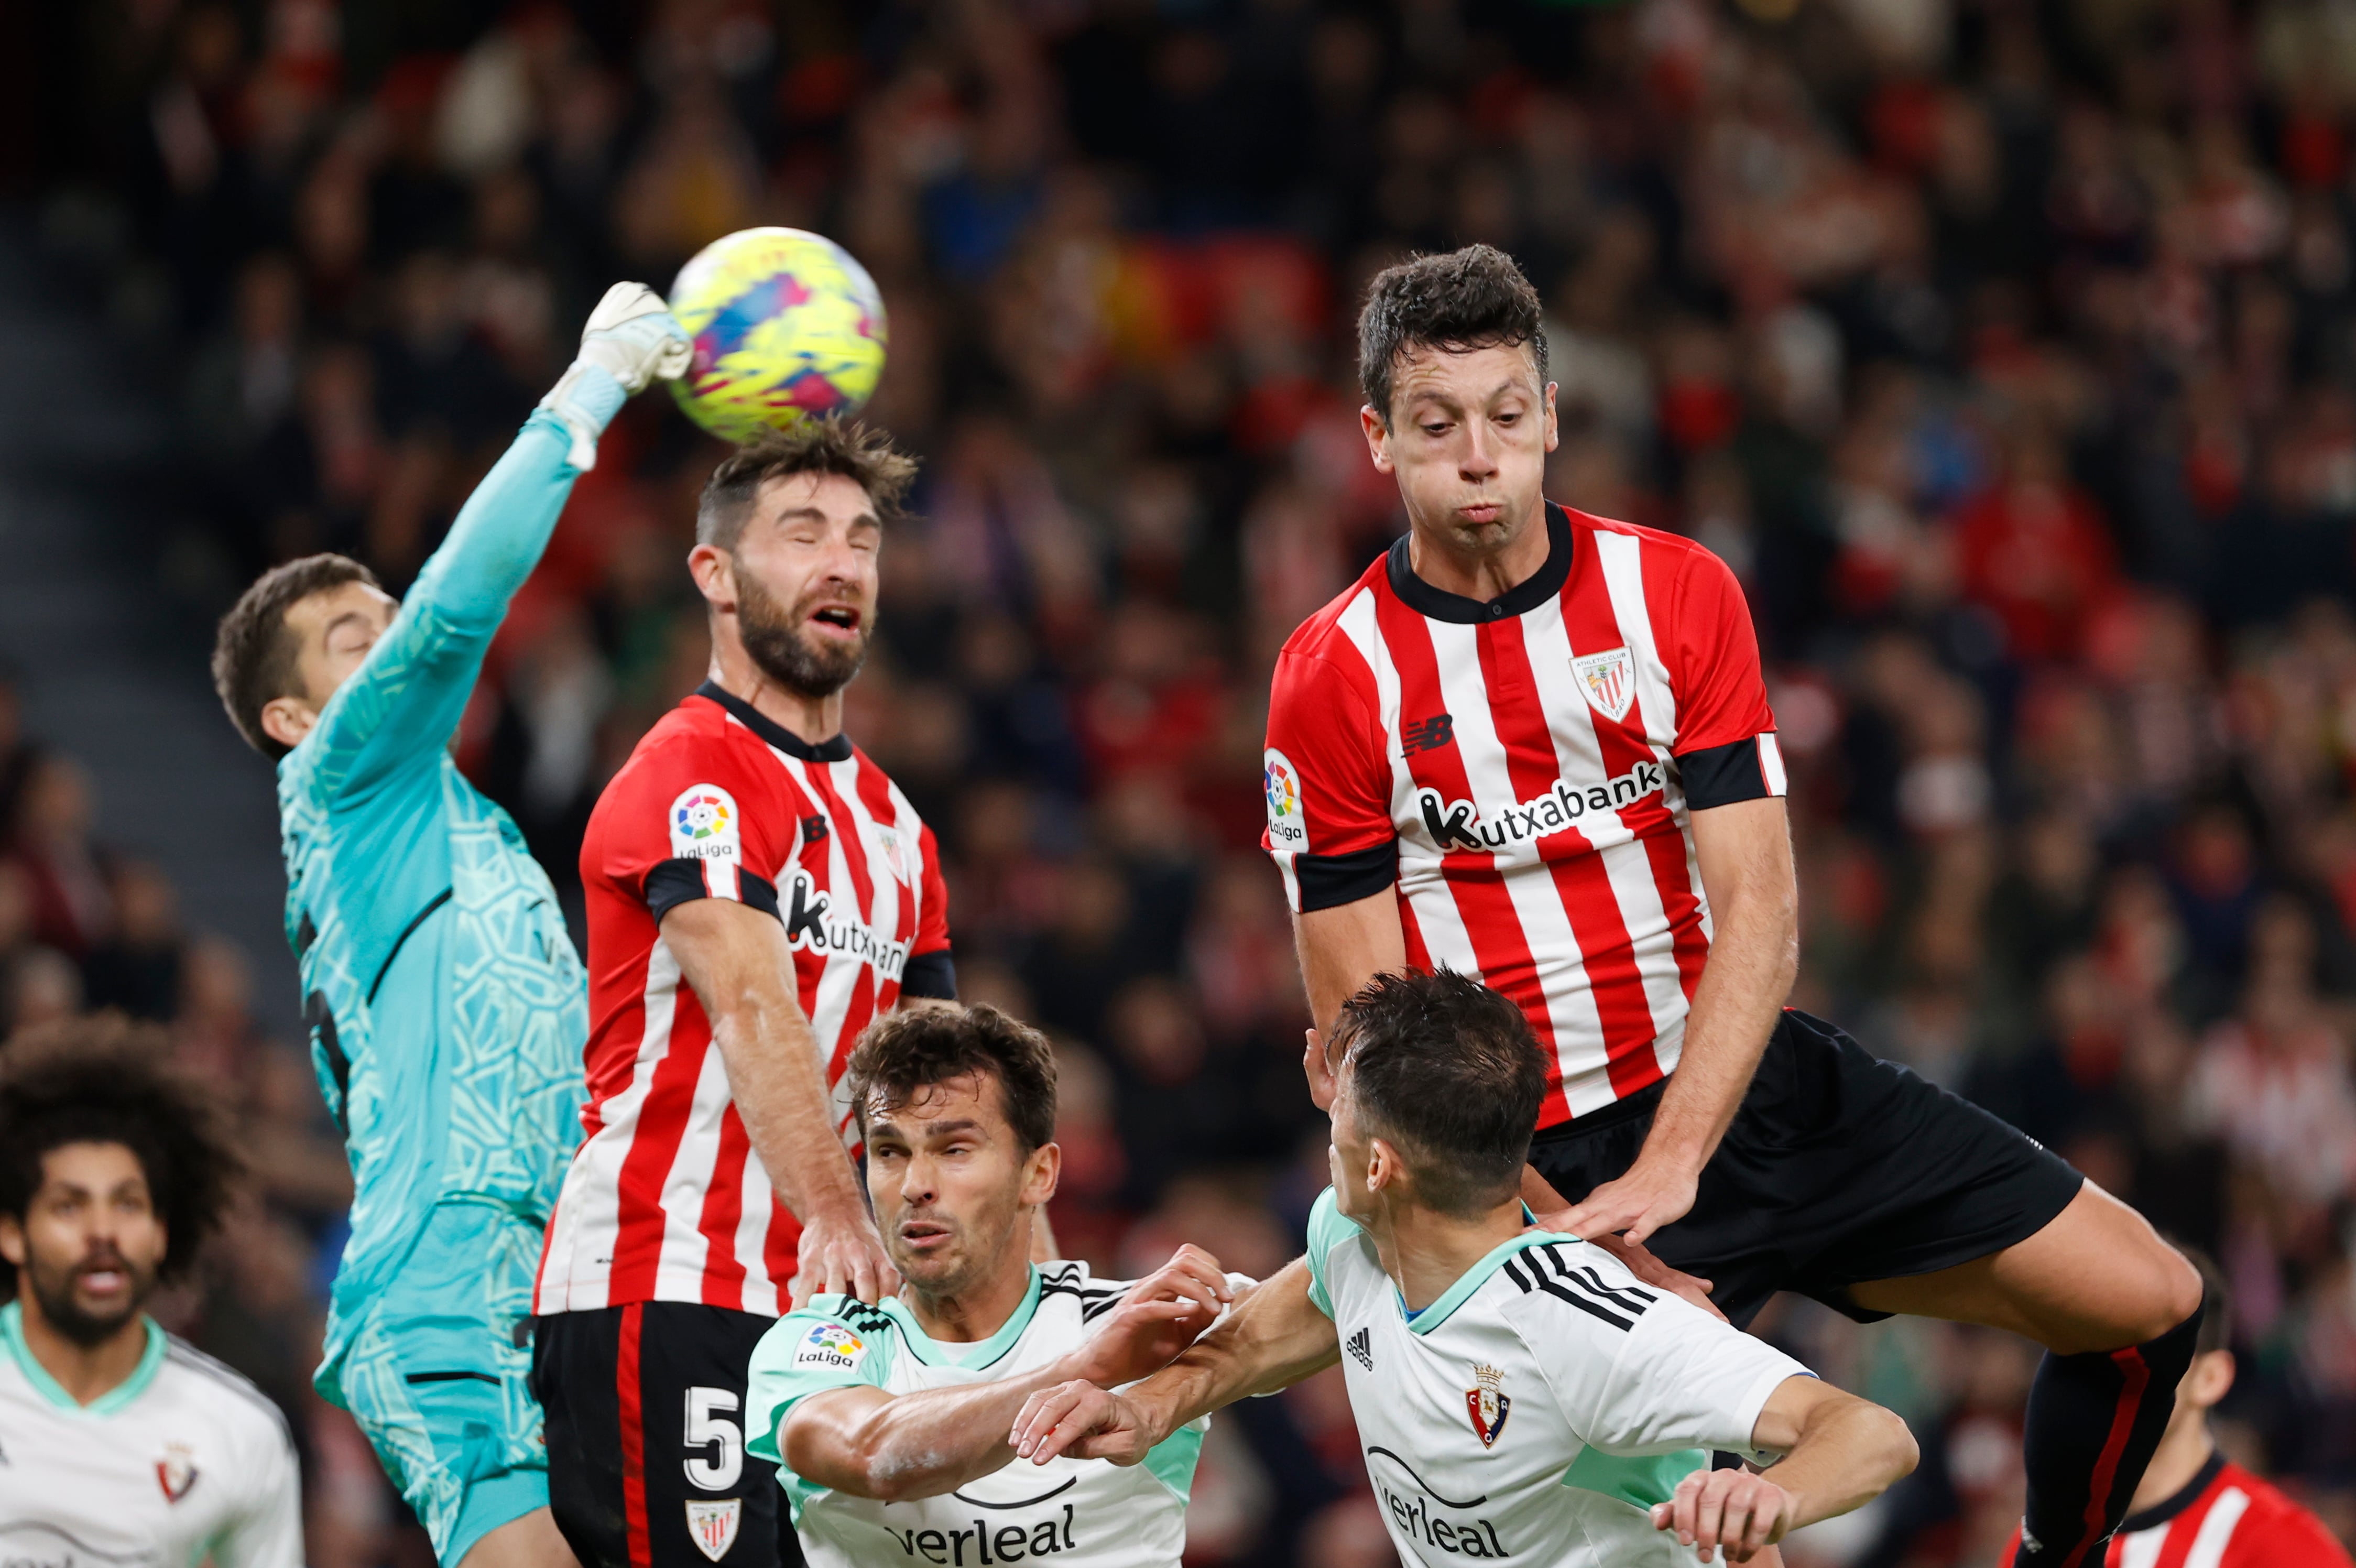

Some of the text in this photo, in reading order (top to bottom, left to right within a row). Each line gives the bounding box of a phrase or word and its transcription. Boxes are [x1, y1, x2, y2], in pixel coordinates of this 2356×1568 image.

[1577, 652, 1626, 667] ATHLETIC CLUB
[1601, 699, 1625, 718] BILBAO
[1420, 765, 1661, 849] Kutxabank
[1269, 819, 1302, 841] LaLiga
[798, 1350, 854, 1368] LaLiga
[1347, 1341, 1373, 1372] adidas
[683, 1386, 743, 1491] 5
[884, 1504, 1076, 1566] verleal
